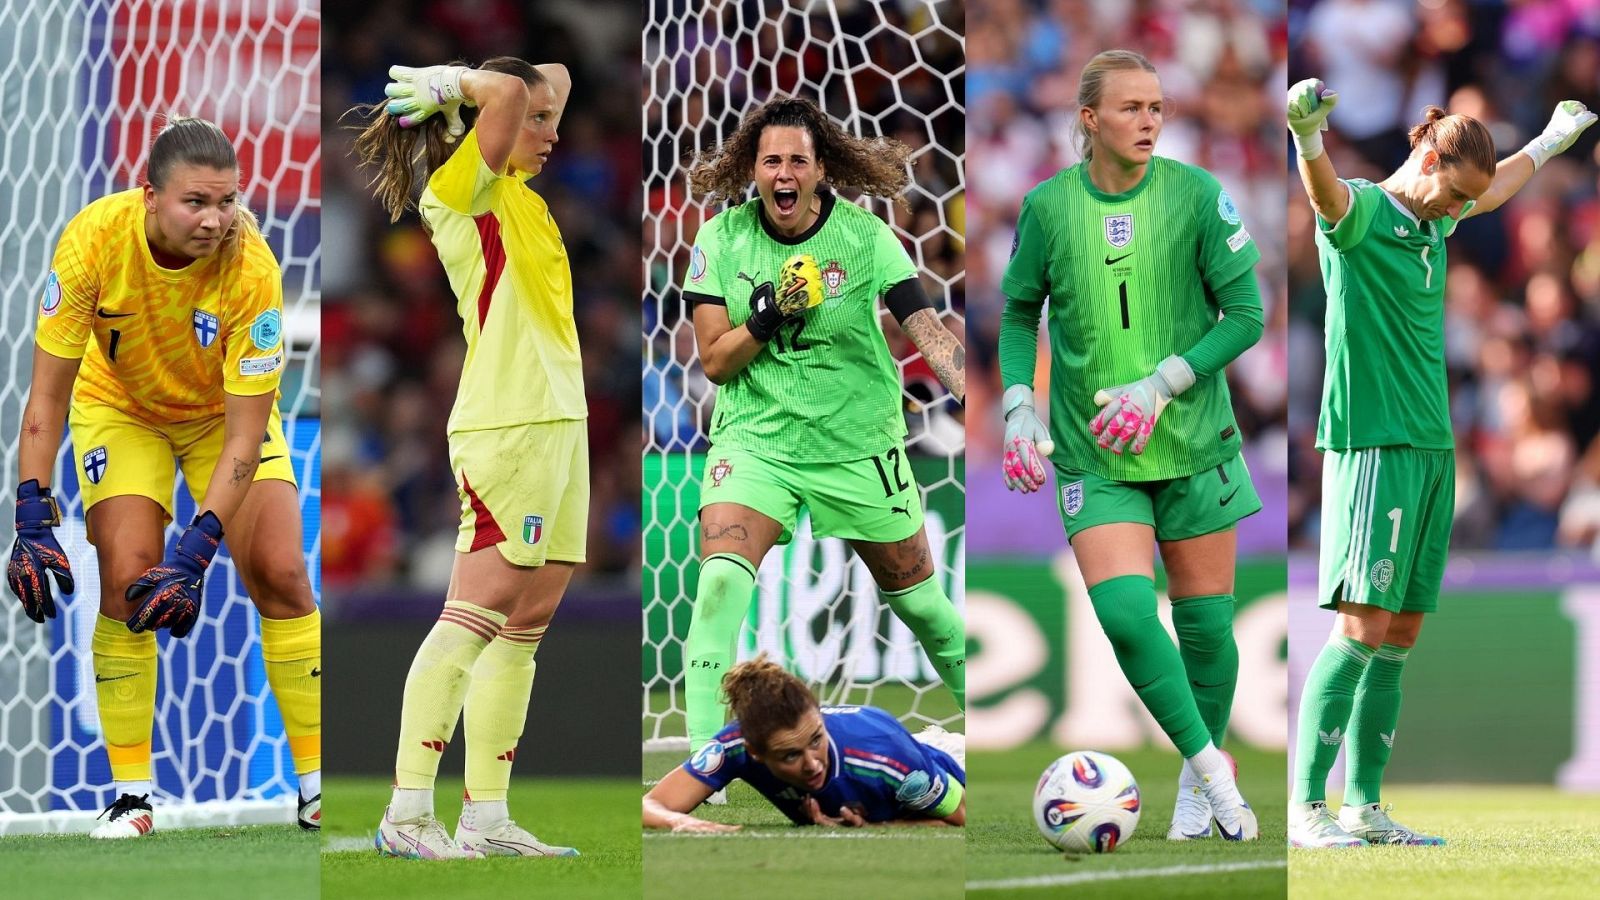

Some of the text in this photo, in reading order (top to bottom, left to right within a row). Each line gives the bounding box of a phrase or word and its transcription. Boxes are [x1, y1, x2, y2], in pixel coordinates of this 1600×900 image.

[1421, 246, 1432, 288] 1
[1119, 280, 1130, 329] 1
[108, 328, 120, 363] 1
[775, 316, 811, 354] 12
[872, 446, 909, 498] 12
[525, 516, 542, 524] ITALIA
[1387, 507, 1403, 553] 1
